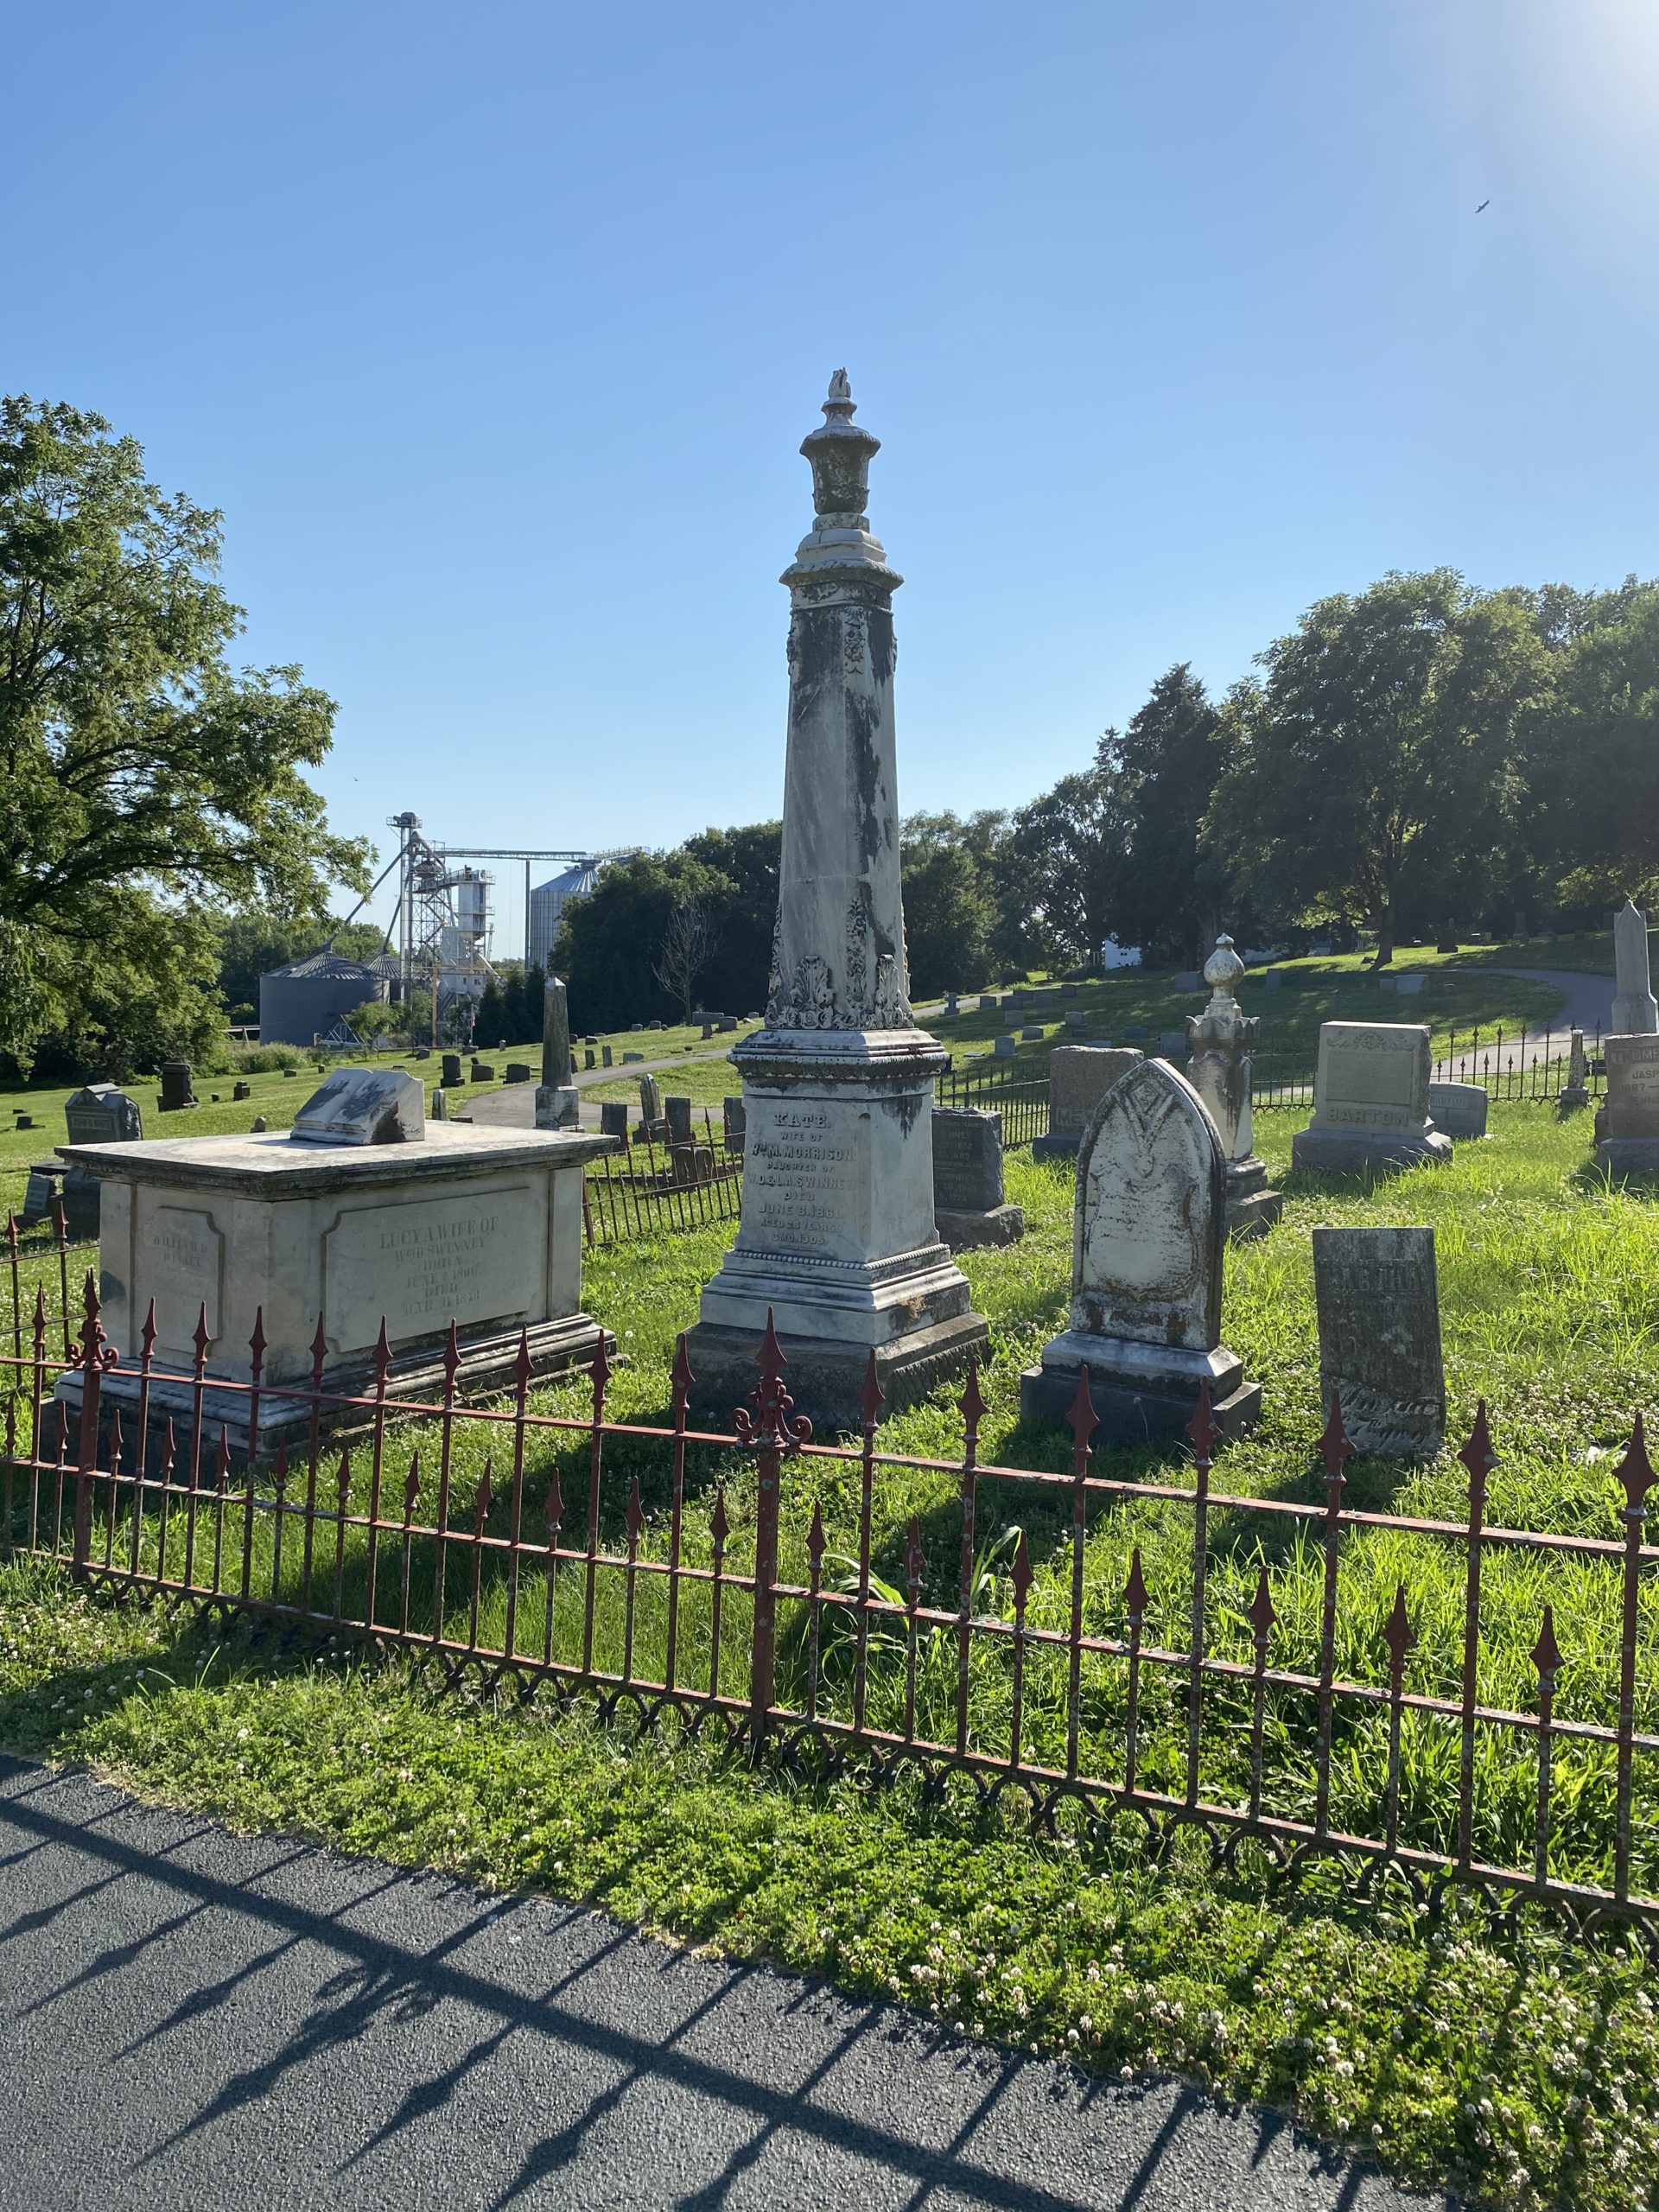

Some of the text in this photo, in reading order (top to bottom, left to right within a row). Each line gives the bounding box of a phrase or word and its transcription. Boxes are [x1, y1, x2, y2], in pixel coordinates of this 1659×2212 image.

[1327, 1107, 1409, 1127] BARTON
[781, 1132, 804, 1141] WIFE
[767, 1163, 817, 1173] DAUGHTER
[785, 1192, 815, 1201] DIED
[760, 1203, 794, 1215] JUNE
[760, 1218, 785, 1229] AGED
[378, 1228, 423, 1249] LUCY
[436, 1218, 476, 1239] WIFE
[480, 1216, 499, 1233] OF
